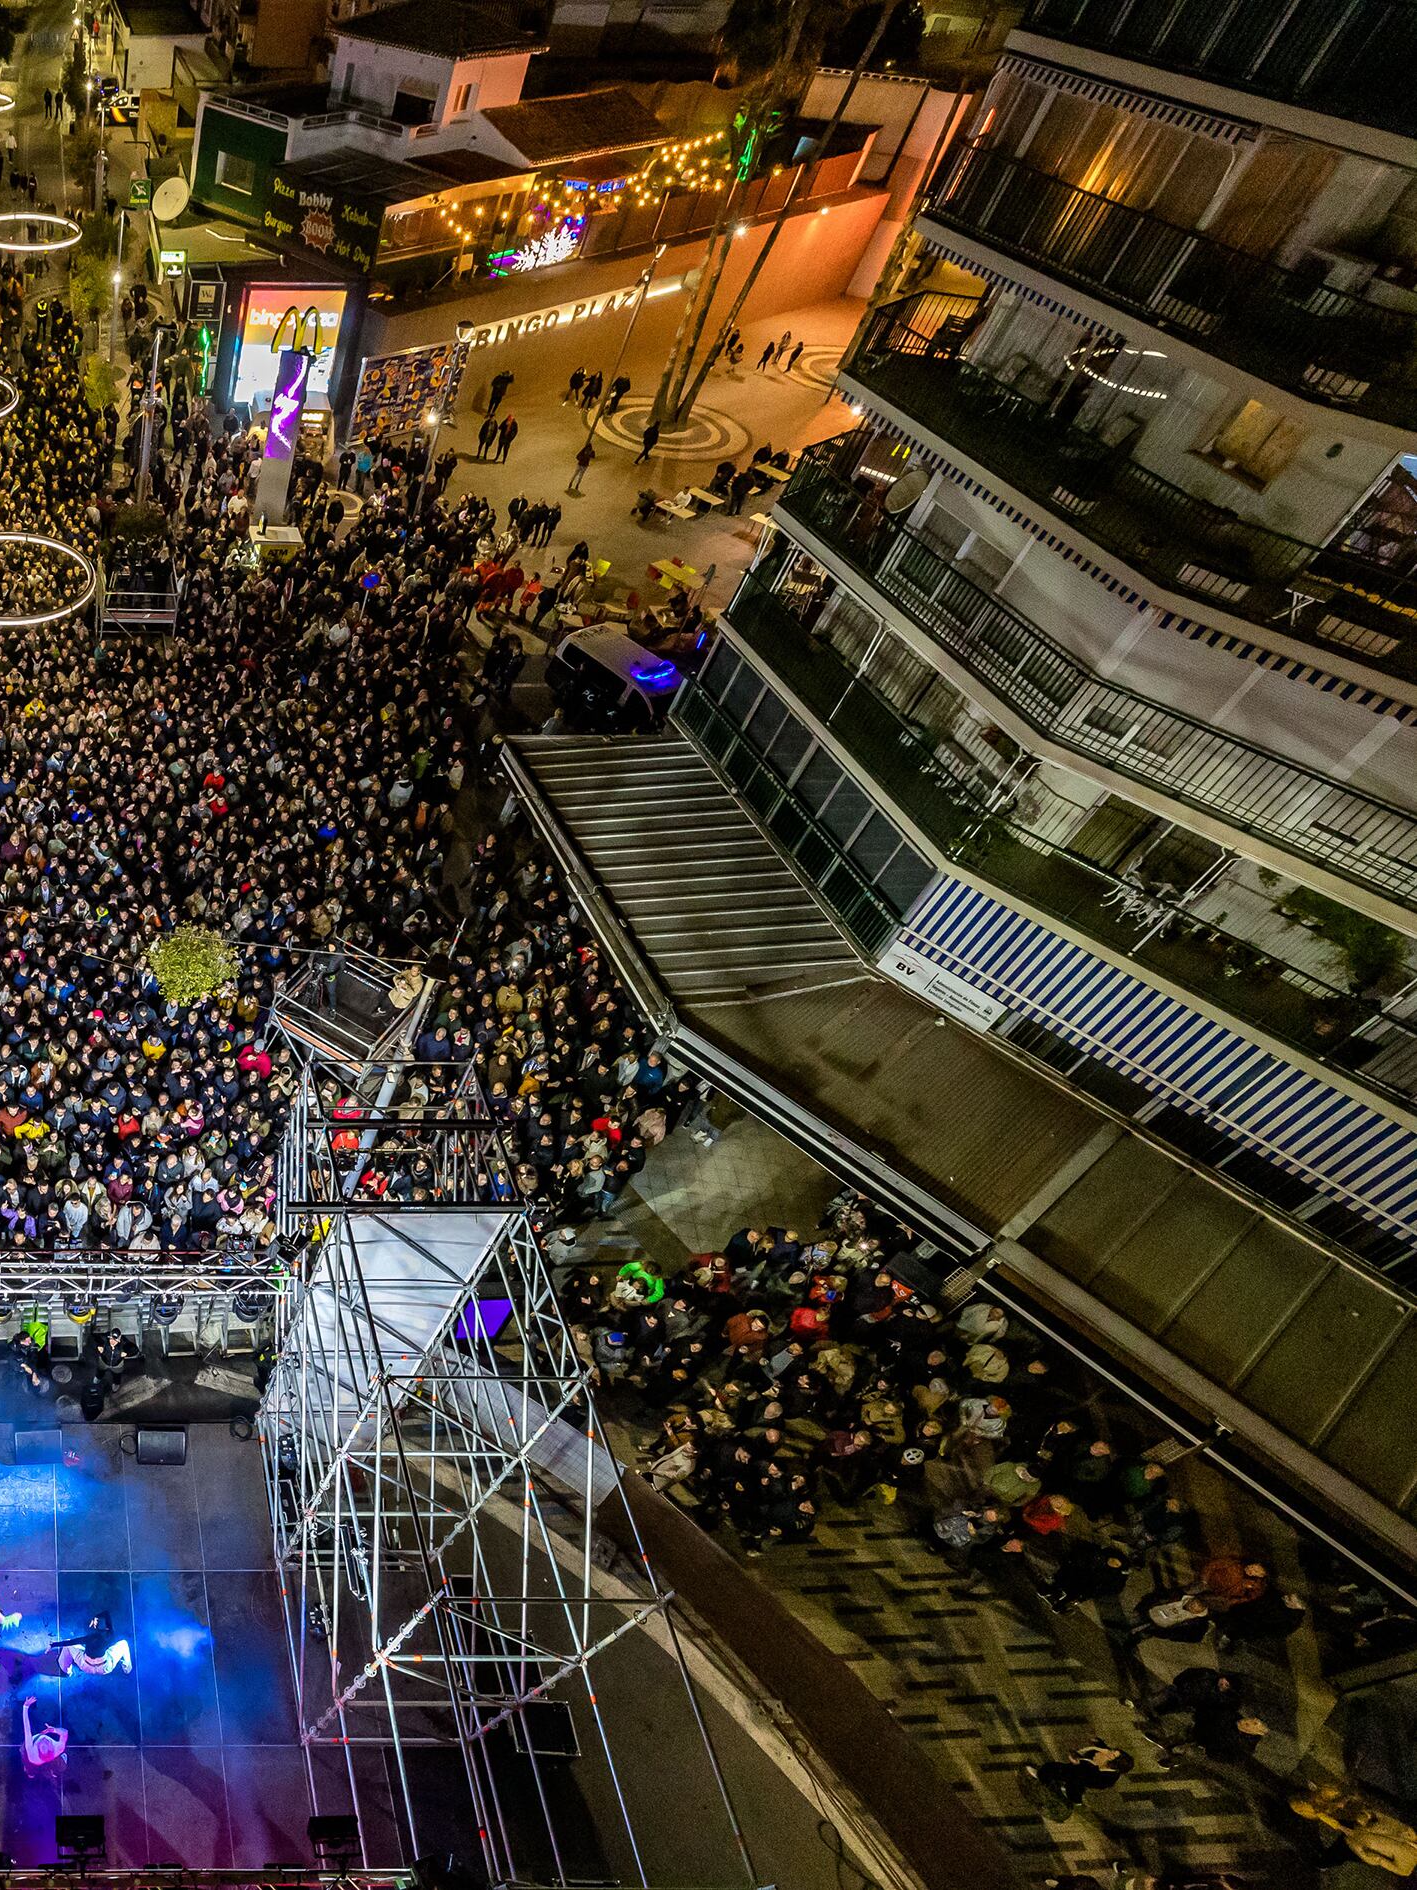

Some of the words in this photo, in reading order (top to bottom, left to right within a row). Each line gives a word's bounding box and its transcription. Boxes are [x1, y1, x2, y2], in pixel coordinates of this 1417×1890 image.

[273, 176, 295, 199] Pizza
[298, 191, 334, 212] Bobby
[264, 210, 294, 237] Burguer
[341, 204, 378, 228] Kebab
[304, 220, 334, 240] BOOM
[334, 240, 350, 257] Hot
[352, 246, 371, 273] Dog
[473, 310, 560, 351] BINGO
[582, 690, 595, 702] PC
[896, 962, 916, 976] BV
